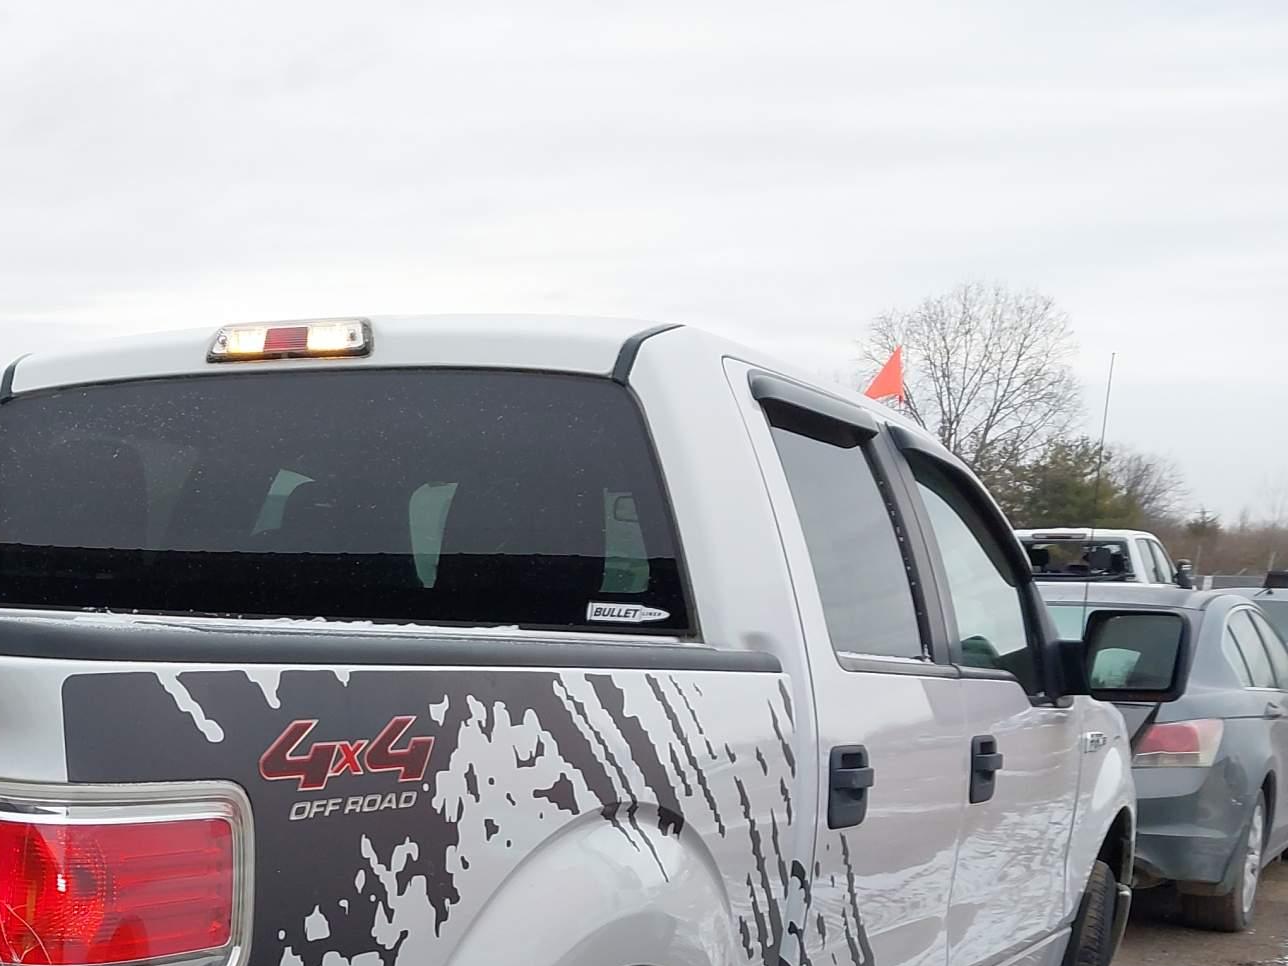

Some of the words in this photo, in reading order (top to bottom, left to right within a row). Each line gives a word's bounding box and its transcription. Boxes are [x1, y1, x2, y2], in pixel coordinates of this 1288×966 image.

[594, 607, 639, 618] BULLET
[289, 797, 343, 821] OFF
[344, 791, 418, 815] ROAD
